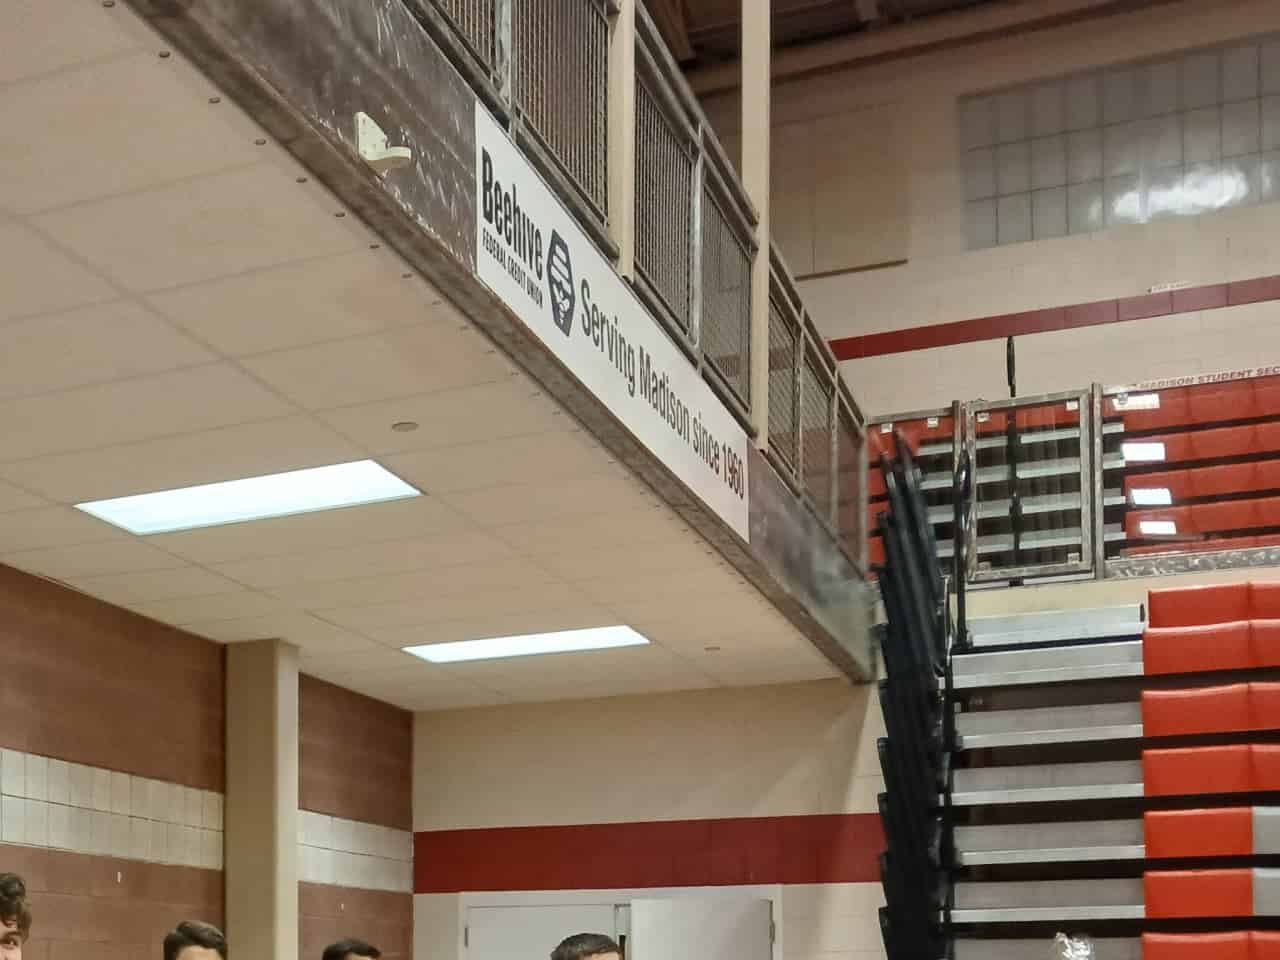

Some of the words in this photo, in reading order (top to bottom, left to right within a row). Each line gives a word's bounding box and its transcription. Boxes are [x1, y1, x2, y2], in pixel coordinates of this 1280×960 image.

[482, 146, 543, 281] Beehive
[483, 227, 507, 271] FEDERAL
[508, 255, 526, 291] CREDIT
[527, 278, 543, 309] UNION
[581, 278, 636, 398] Serving
[639, 345, 690, 442] Madison
[693, 411, 720, 475] since
[722, 442, 745, 500] 1960
[1198, 369, 1255, 384] STUDENT
